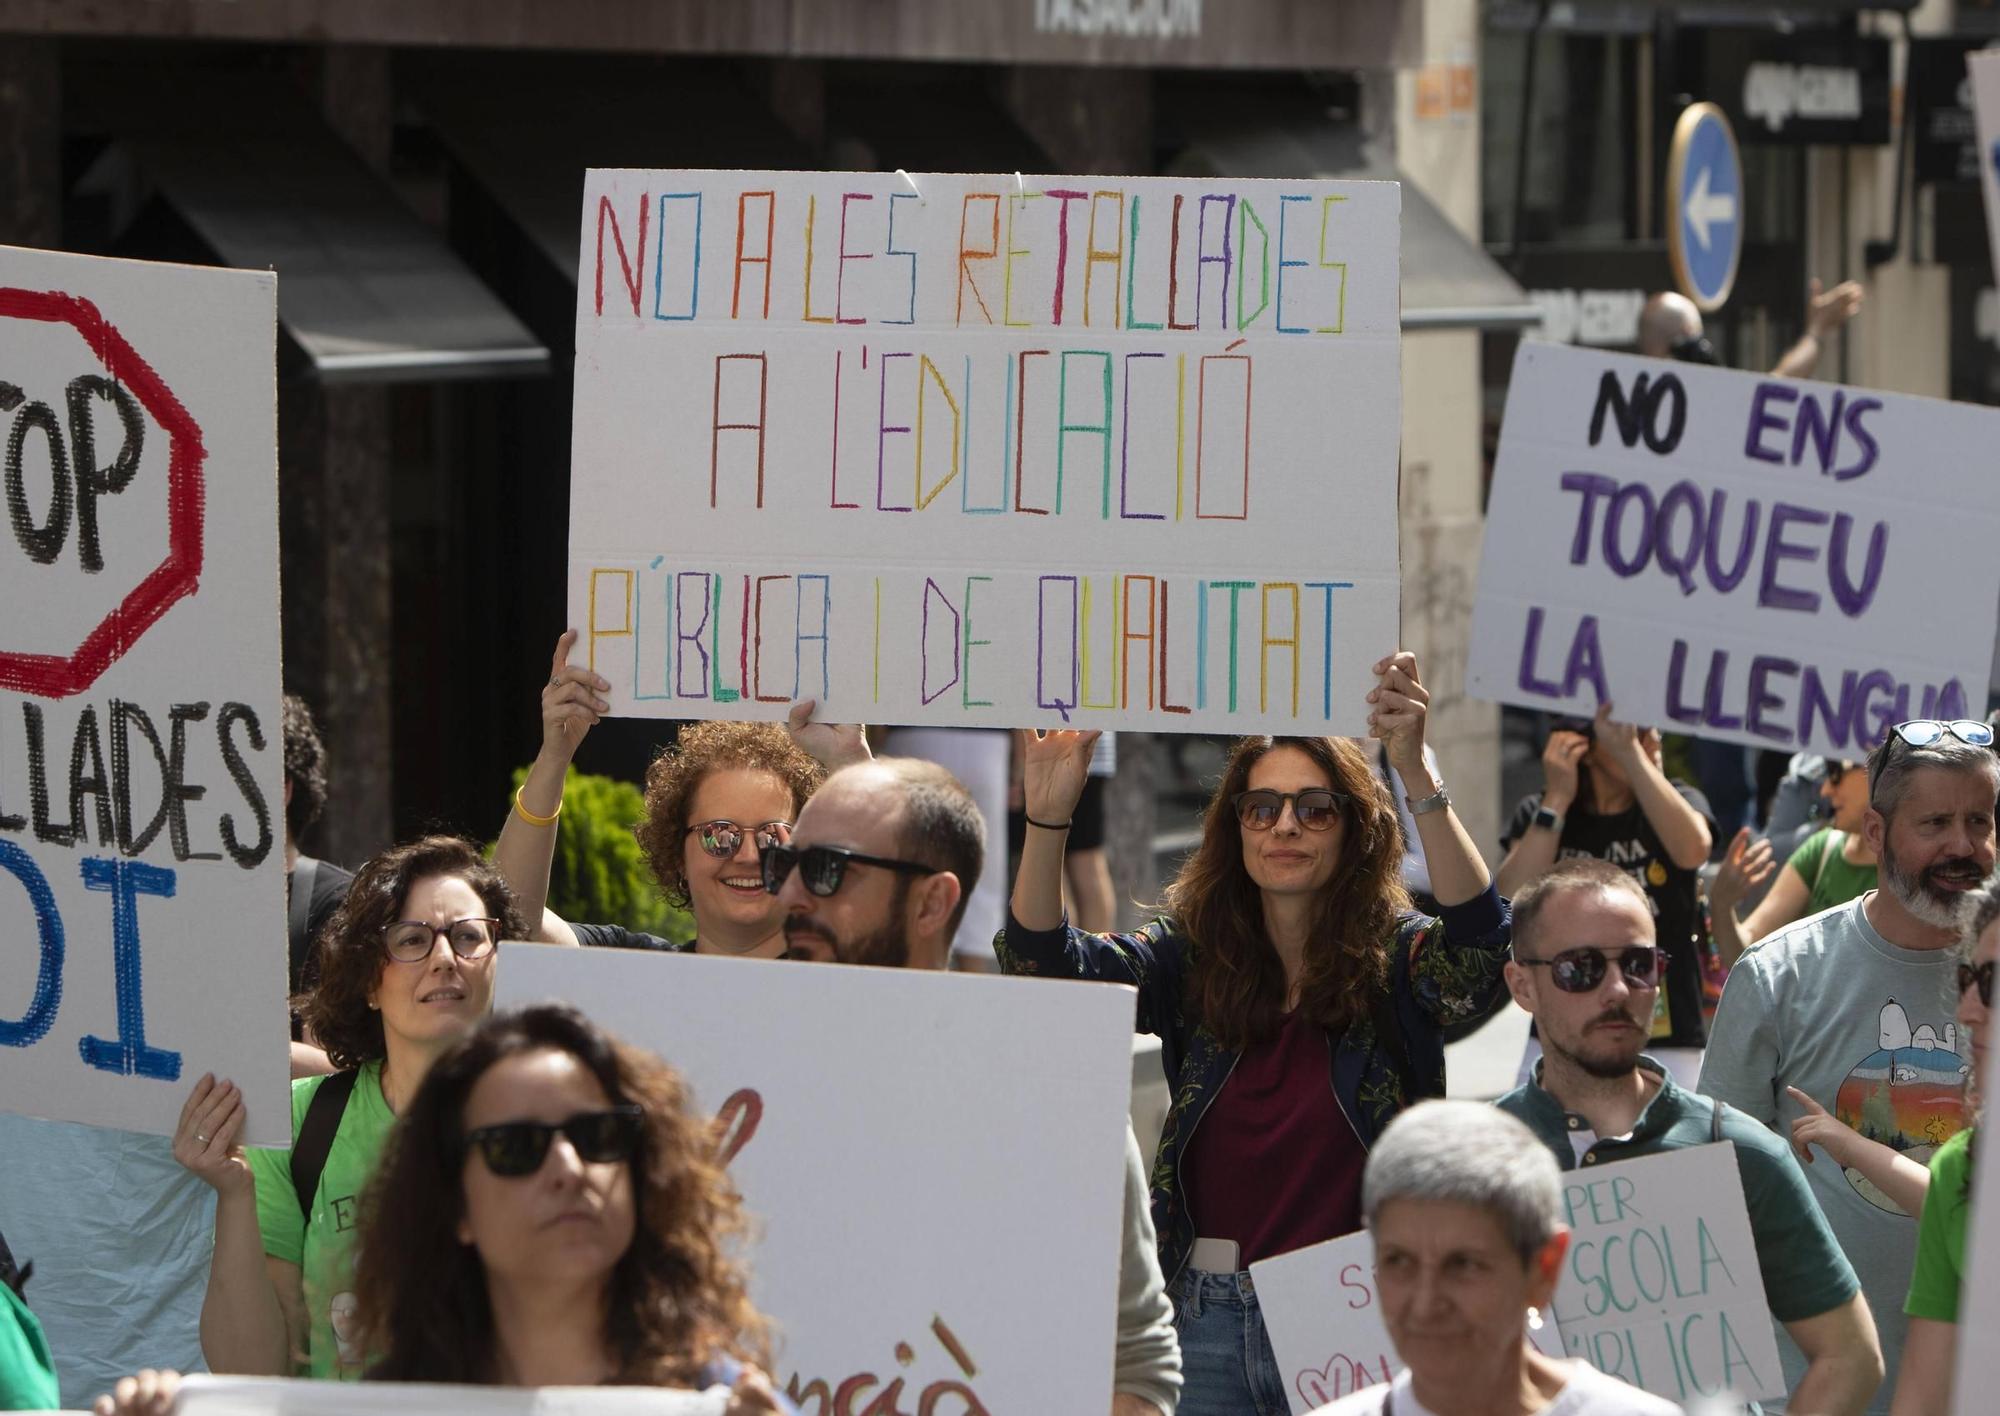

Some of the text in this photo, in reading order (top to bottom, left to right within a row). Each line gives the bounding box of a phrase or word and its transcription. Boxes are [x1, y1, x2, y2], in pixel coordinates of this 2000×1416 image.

[596, 188, 1349, 333] NO A LES RETALLADES
[712, 339, 1251, 521] A L'EDUCACIÓ
[1588, 370, 1883, 481] NO ENS
[1561, 472, 1889, 618] TOQUEU
[589, 555, 830, 702] PÚBLICA
[922, 576, 993, 710] DE
[1037, 575, 1354, 722] QUALITAT
[1518, 607, 1610, 703] LA
[1557, 1216, 1737, 1325] SCOLA
